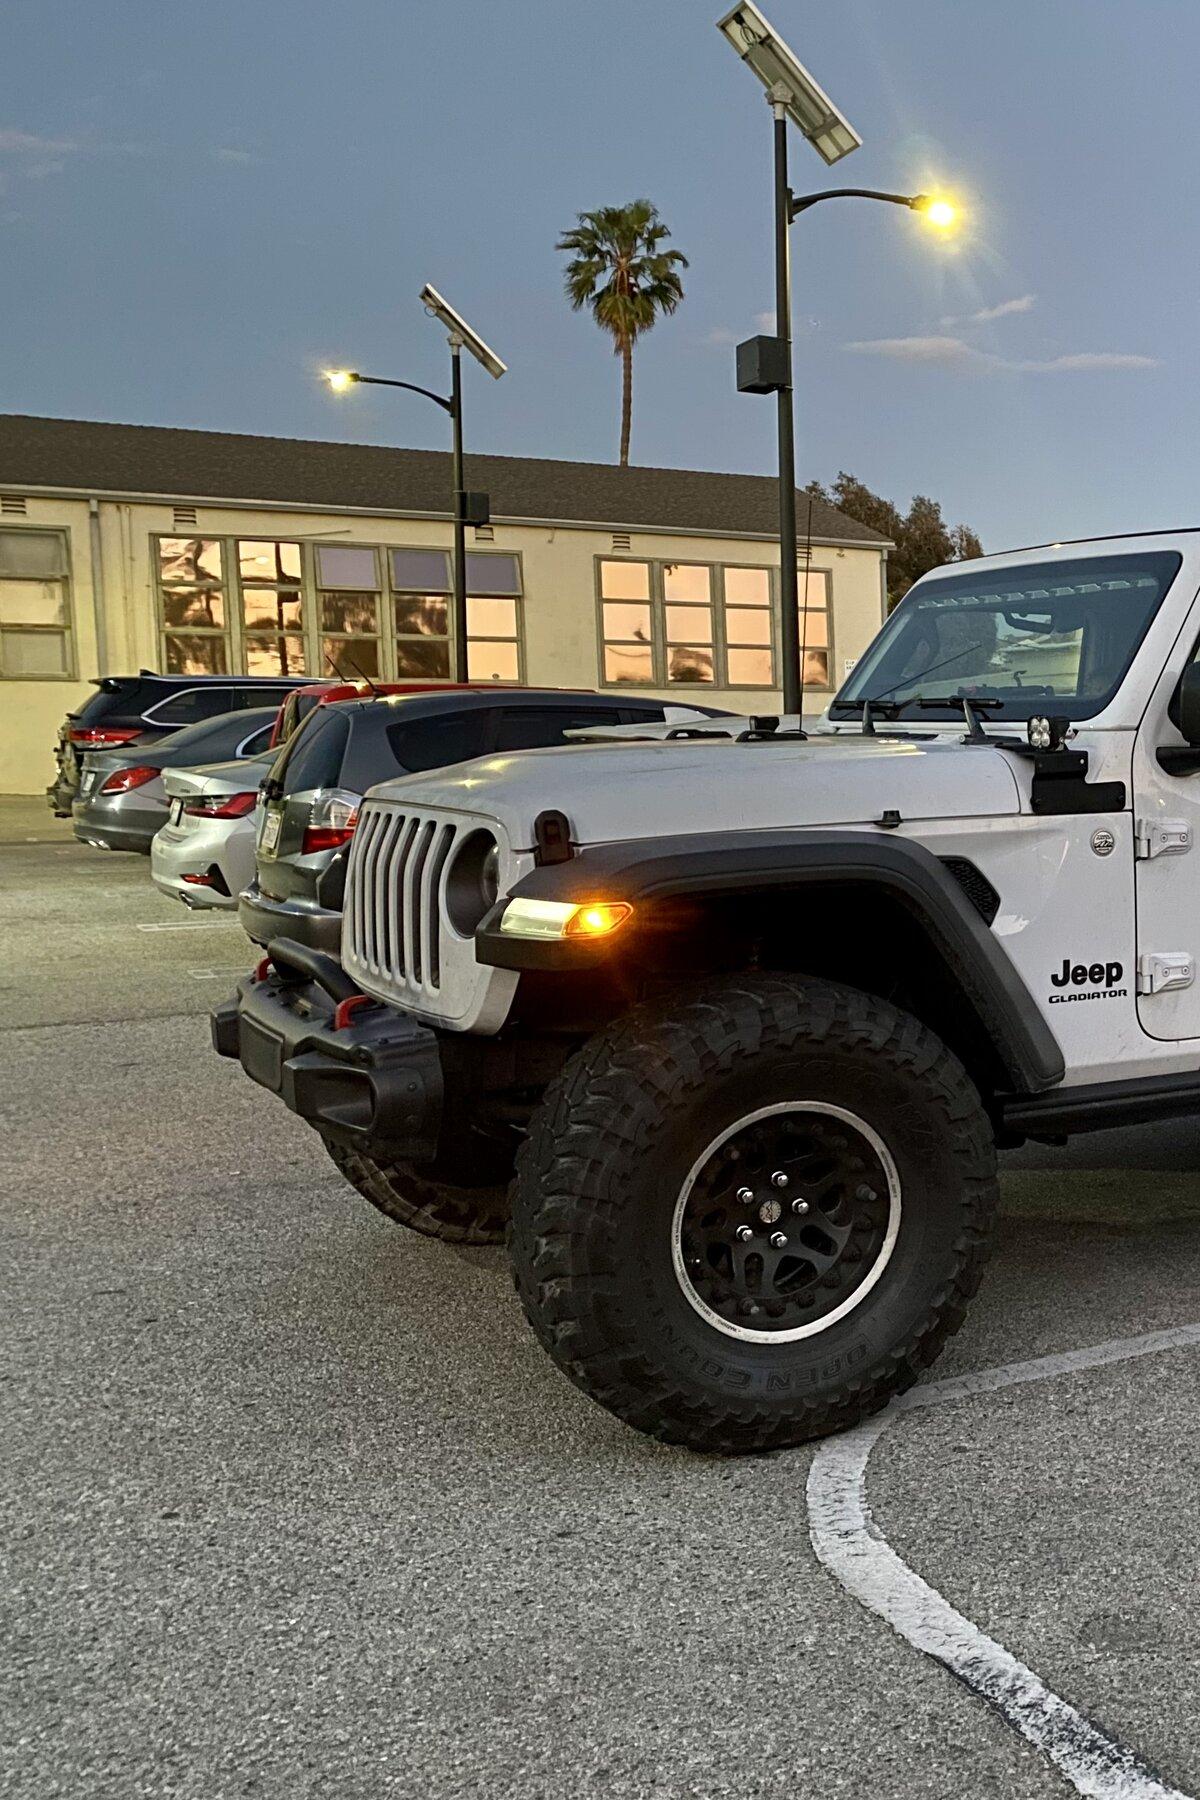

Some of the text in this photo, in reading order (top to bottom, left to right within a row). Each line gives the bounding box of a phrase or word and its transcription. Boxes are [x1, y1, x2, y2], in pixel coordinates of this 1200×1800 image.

[1051, 959, 1123, 988] Jeep
[1048, 989, 1128, 1004] GLADIATOR
[767, 1344, 867, 1392] OPEN
